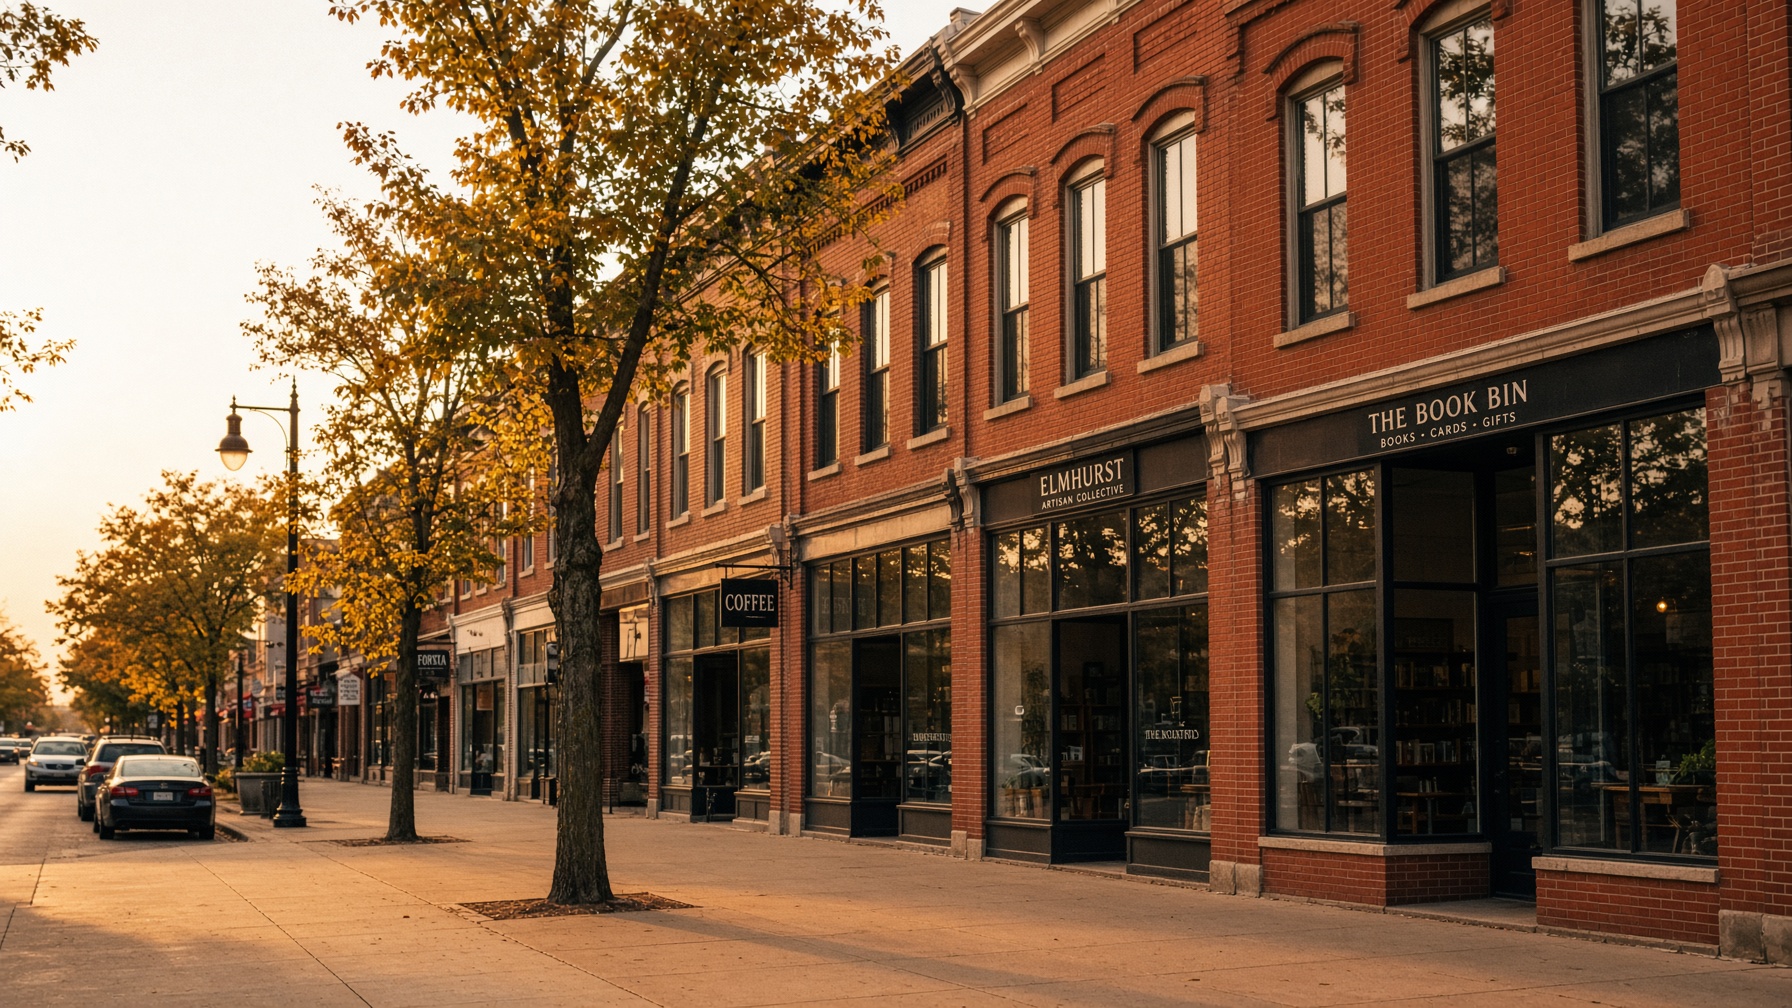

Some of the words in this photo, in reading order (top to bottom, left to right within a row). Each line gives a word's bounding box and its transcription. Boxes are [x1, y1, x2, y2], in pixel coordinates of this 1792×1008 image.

[1368, 406, 1407, 434] THE
[1415, 390, 1478, 425] BOOK
[1487, 379, 1528, 410] BIN
[1380, 431, 1416, 448] BOOKS
[1430, 421, 1467, 438] CARDS
[1482, 411, 1516, 428] GIFTS
[1040, 457, 1124, 497] ELMHURST
[1041, 495, 1074, 510] ARTISAN
[1076, 483, 1124, 503] COLLECTIVE
[725, 593, 775, 612] COFFEE
